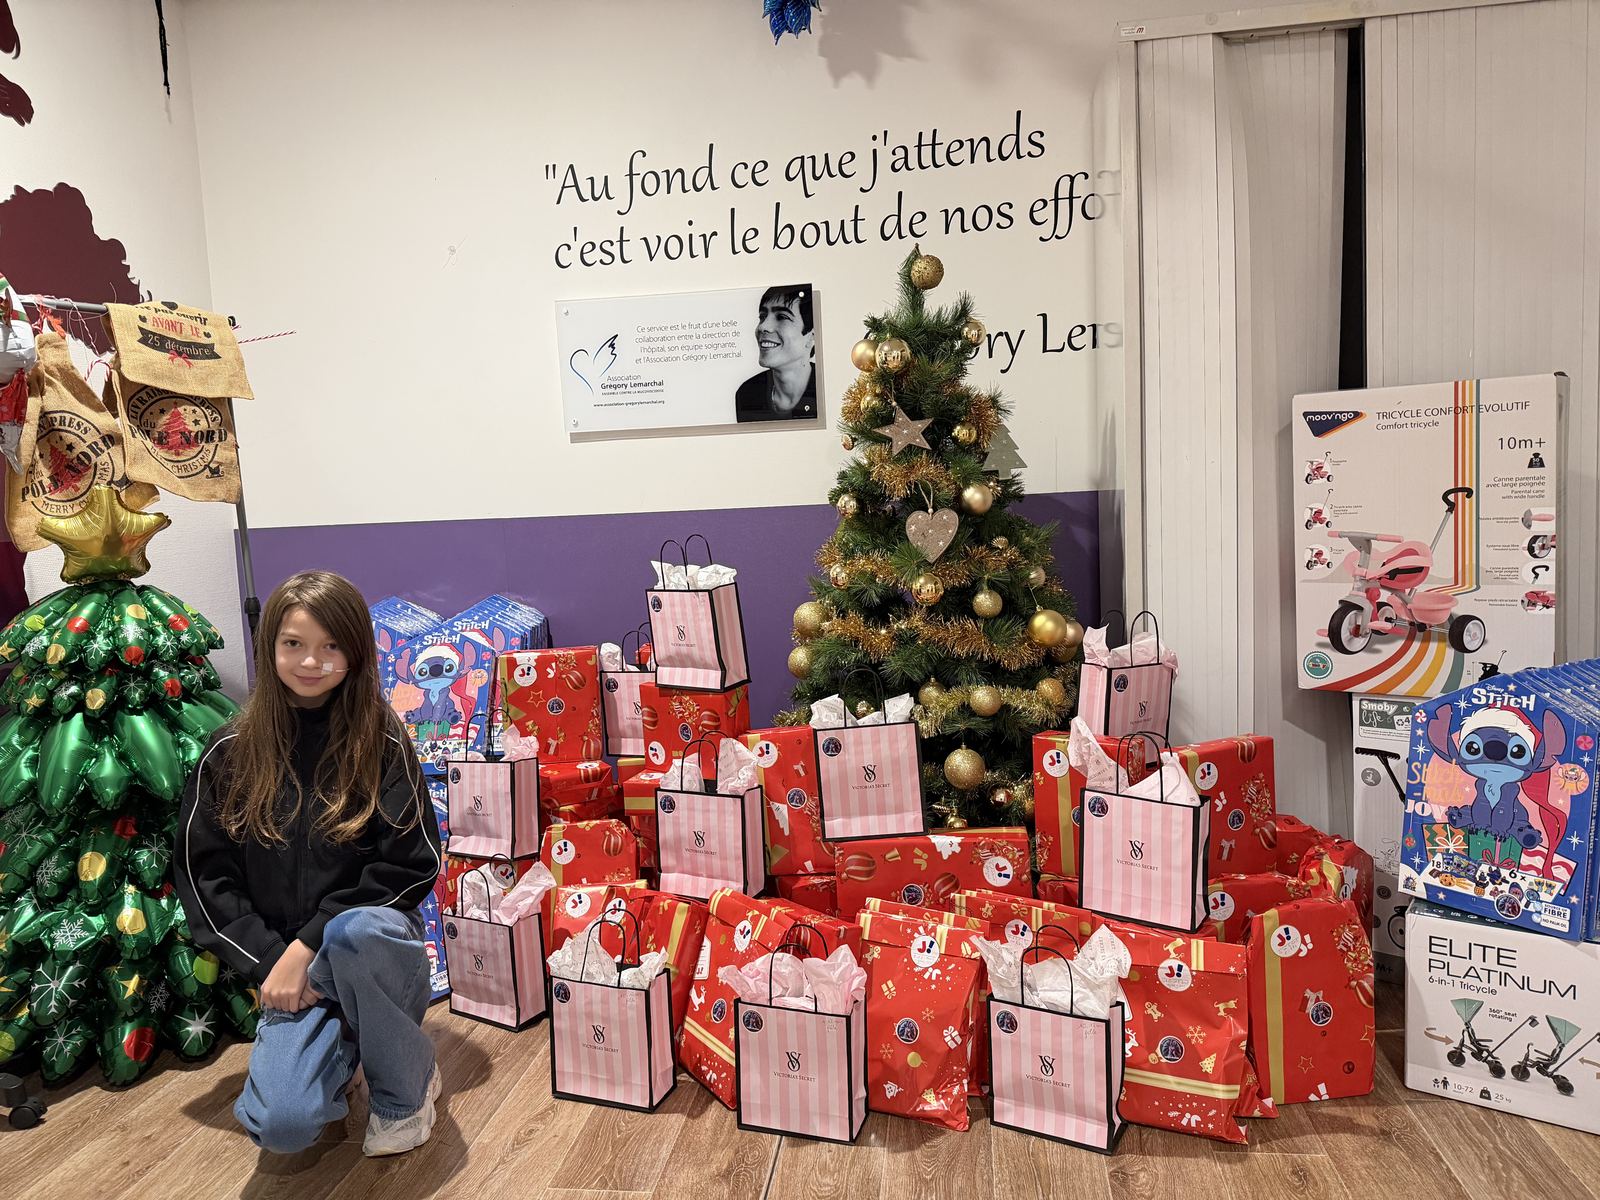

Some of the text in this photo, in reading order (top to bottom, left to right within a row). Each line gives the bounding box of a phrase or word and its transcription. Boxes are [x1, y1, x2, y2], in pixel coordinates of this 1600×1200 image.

[545, 110, 1045, 215] "Au fond ce que j'attends
[555, 226, 632, 269] c'est
[640, 220, 718, 261] voir
[731, 208, 759, 255] le
[773, 202, 866, 250] bout
[880, 191, 927, 241] de
[940, 200, 1014, 235] nos
[152, 316, 201, 338] AVANT LE
[688, 322, 701, 330] fruit
[703, 321, 720, 329] d'une
[635, 334, 675, 343] collaboration
[695, 332, 701, 340] la
[702, 331, 730, 339] direction
[148, 334, 210, 356] 25 décembre
[681, 343, 703, 352] équipe
[682, 353, 708, 362] Grégory
[607, 374, 641, 382] Association
[630, 379, 664, 388] Lemarchal
[1376, 401, 1530, 420] TRICYCLE CONFORT EVOLUTIF
[143, 419, 156, 429] du
[1376, 420, 1439, 431] Comfort tricycle
[179, 428, 227, 445] NORD
[1499, 437, 1546, 450] 10m+
[65, 433, 115, 478] NORD
[41, 500, 75, 514] MERRY
[1361, 700, 1398, 715] Smoby
[1362, 710, 1384, 728] life
[1432, 859, 1442, 869] 18
[1509, 869, 1518, 879] 6
[1543, 907, 1568, 919] FIBRE
[1428, 935, 1517, 969] ELITE
[1428, 958, 1576, 1000] PLATINUM
[1428, 975, 1497, 995] 6-in-1 Tricycle
[1488, 1013, 1513, 1022] rotating
[1053, 1080, 1071, 1088] SECRET
[1453, 1083, 1474, 1093] 10-72
[1494, 1093, 1504, 1101] 25
